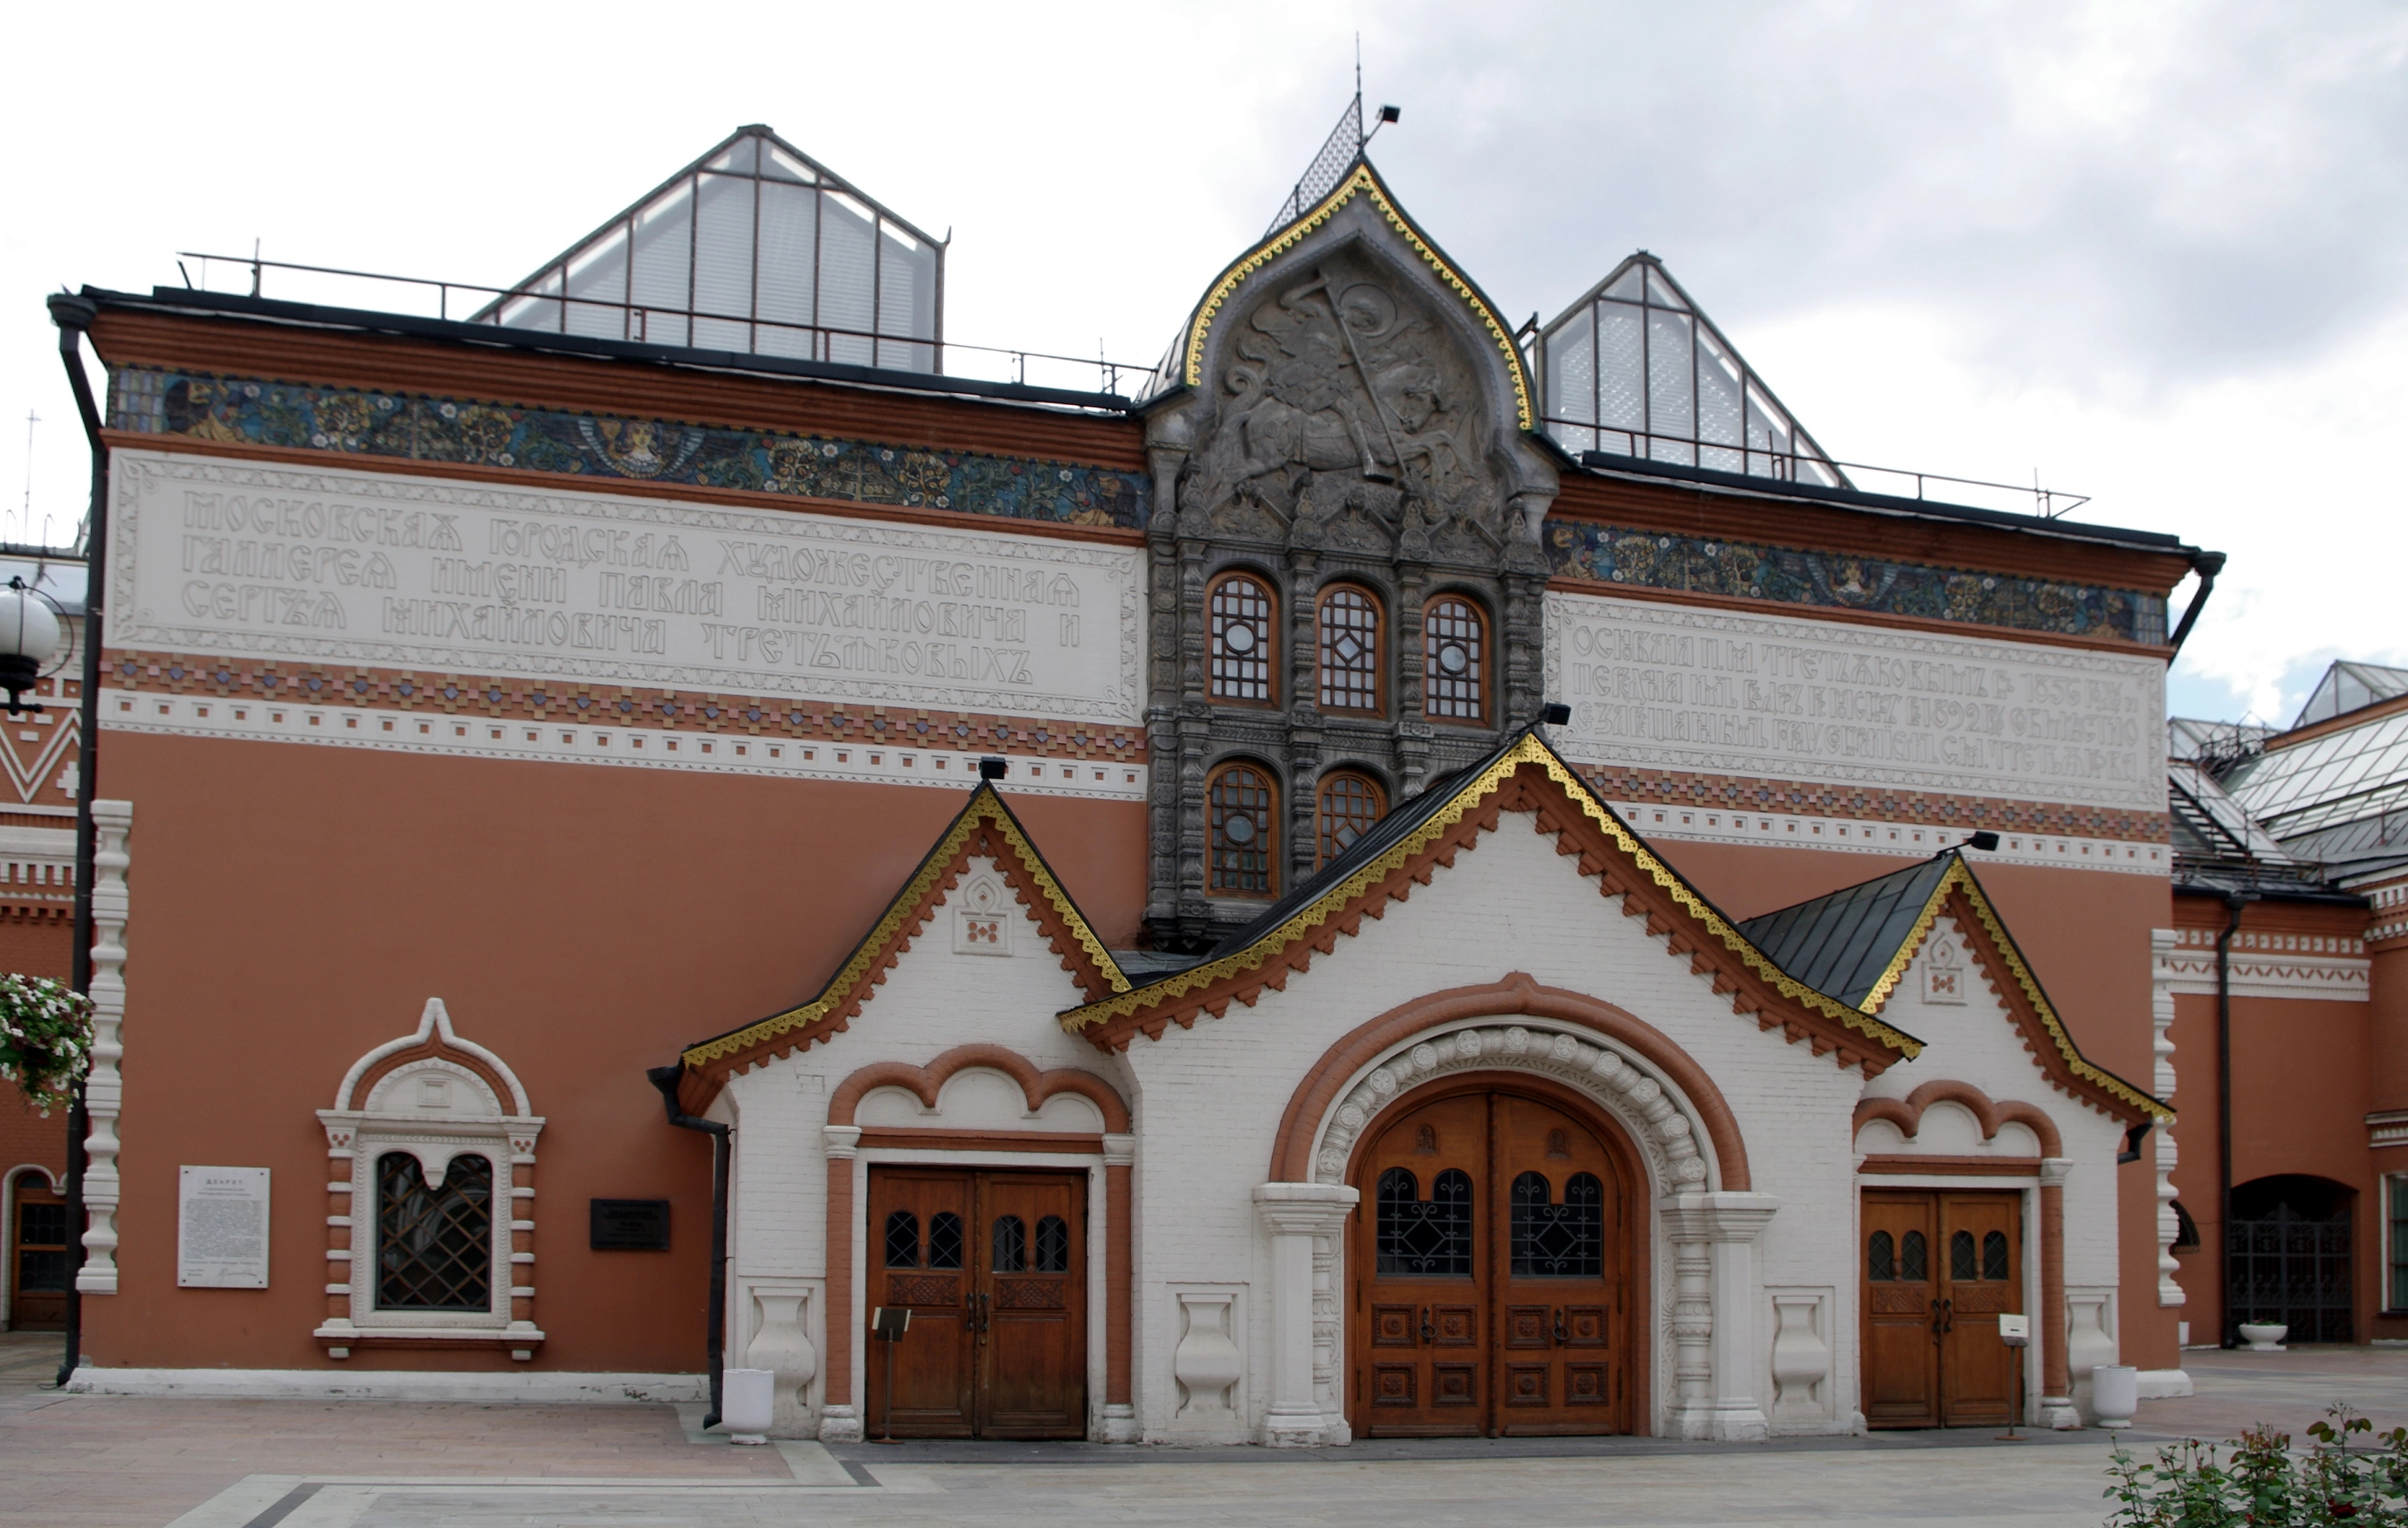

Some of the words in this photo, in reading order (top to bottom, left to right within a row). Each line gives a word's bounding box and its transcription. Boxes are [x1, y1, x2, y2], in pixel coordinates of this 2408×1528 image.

[383, 596, 666, 655] МИХАЙЛОВИЧА
[431, 556, 567, 604] ИМЕНИ
[599, 572, 723, 616] ПАВЛА
[757, 584, 1026, 644] МИХАЙЛОВИЧА
[1059, 614, 1080, 647] И
[2020, 672, 2081, 707] 1856
